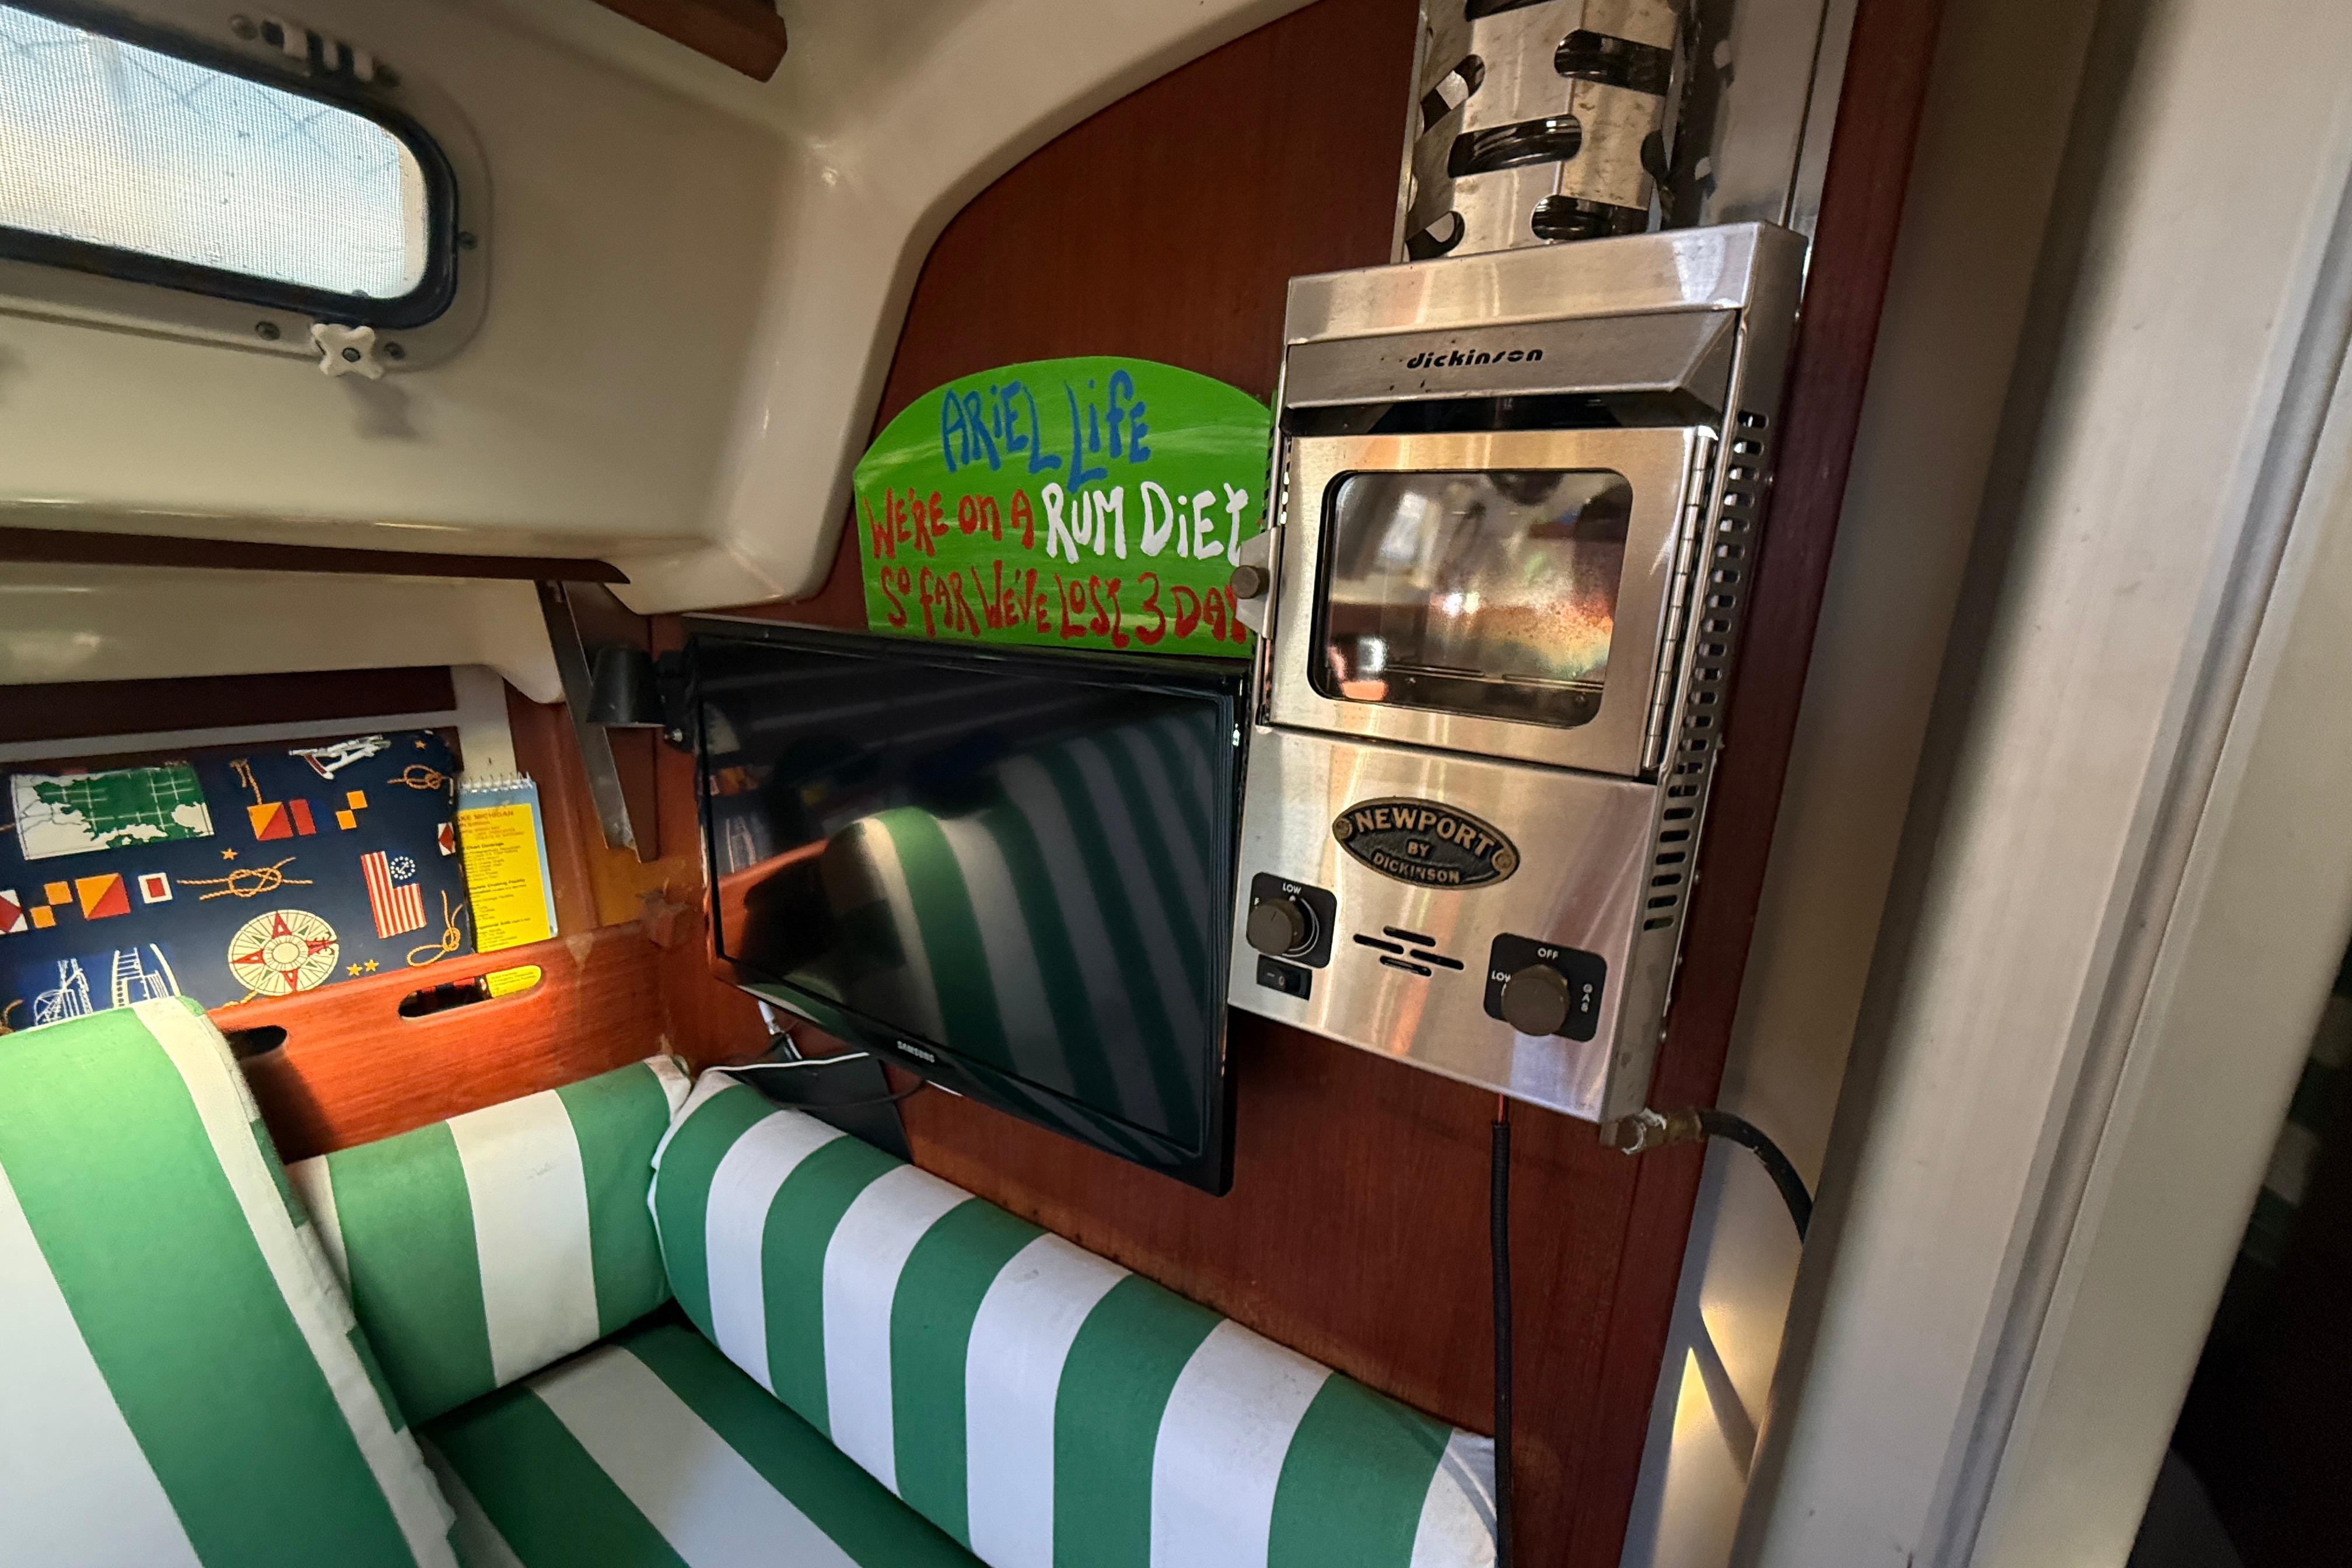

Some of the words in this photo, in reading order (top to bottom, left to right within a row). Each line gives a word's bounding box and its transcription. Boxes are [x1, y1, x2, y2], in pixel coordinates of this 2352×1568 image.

[1406, 349, 1543, 369] dickinson
[1010, 489, 1034, 550] A
[1041, 482, 1127, 564] RUM
[1135, 572, 1166, 645] 3
[1354, 807, 1495, 858] NEWPORT
[1407, 841, 1430, 857] BY
[1373, 852, 1462, 884] DICKINSON
[1282, 882, 1302, 895] LOW
[1537, 947, 1559, 960] OFF
